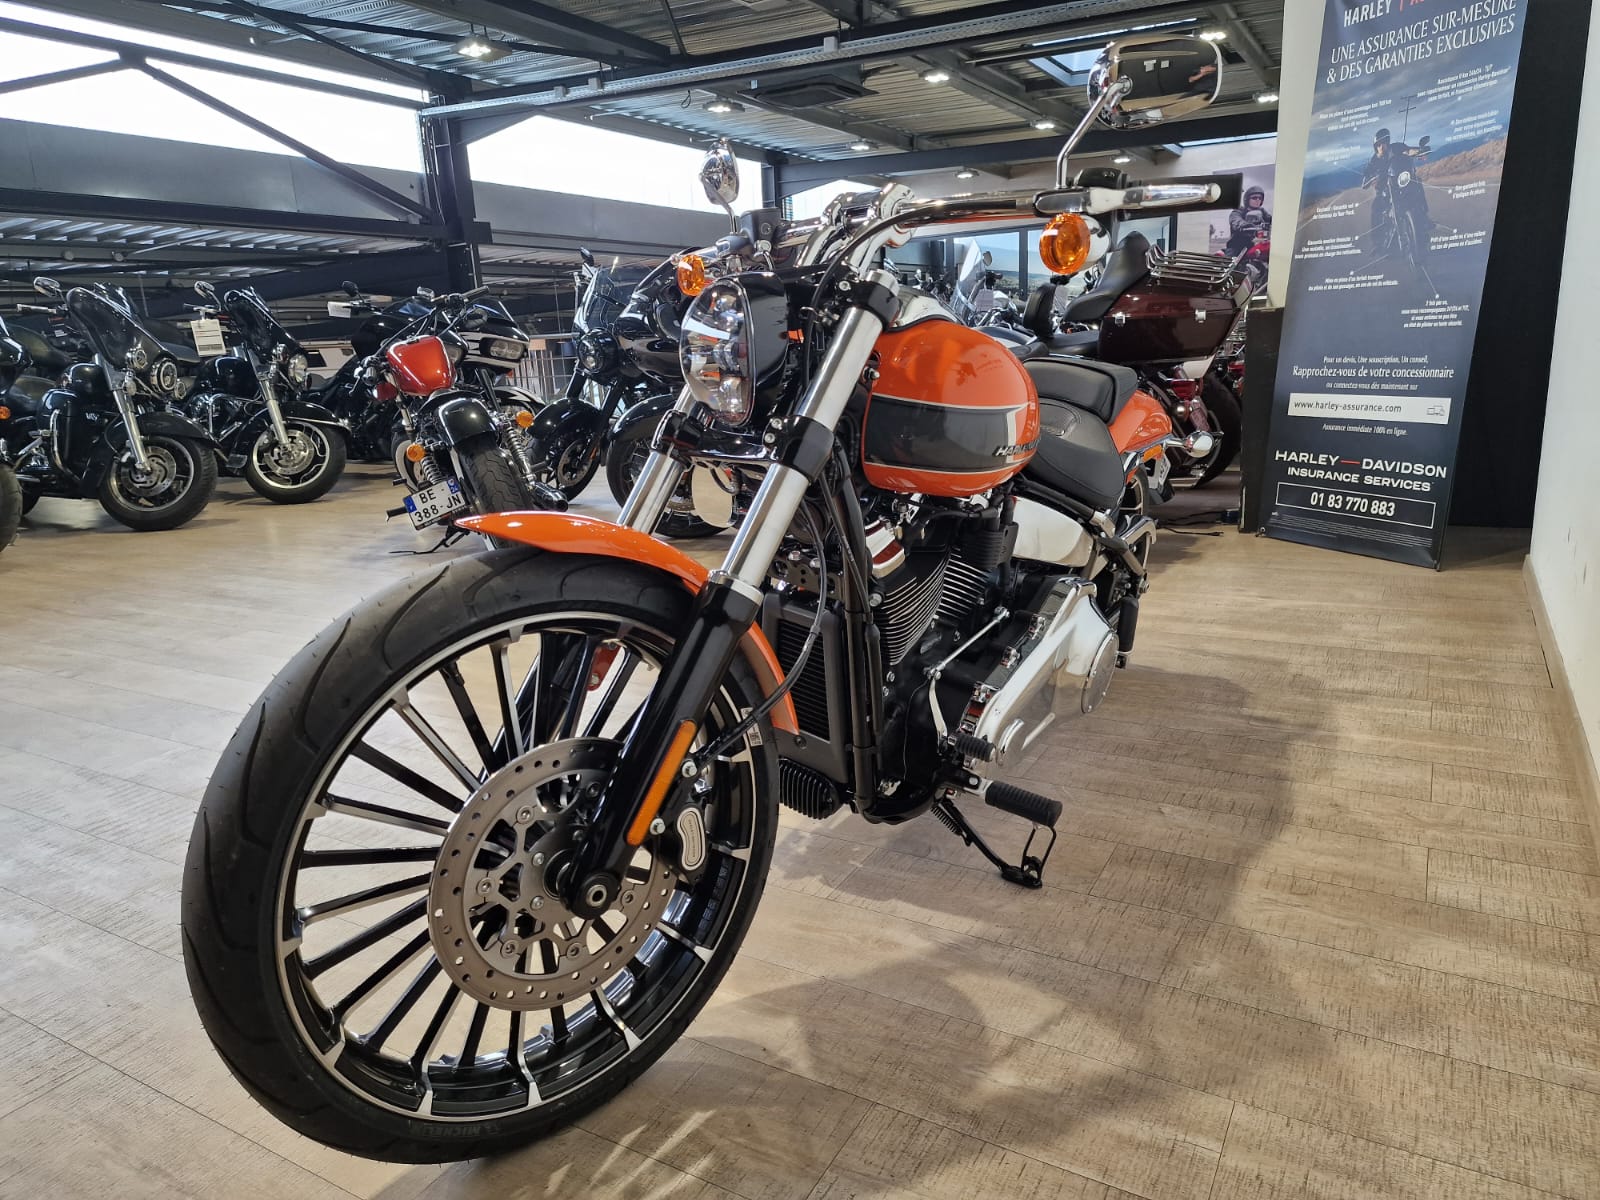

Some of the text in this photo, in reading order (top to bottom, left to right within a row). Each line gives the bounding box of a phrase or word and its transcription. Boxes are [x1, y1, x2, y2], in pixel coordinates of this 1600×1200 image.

[1344, 0, 1392, 27] HARLEY
[1326, 13, 1516, 84] & DES GARANTIES EXCLUSIVES
[1331, 42, 1355, 64] UNE
[1357, 19, 1429, 57] ASSURANCE
[1292, 366, 1455, 380] Rapprochez-vous de votre concessionnaire
[1294, 401, 1402, 413] www.harley-assurance.com
[1275, 450, 1447, 479] HARLEY DAVIDSON
[1287, 466, 1431, 492] INSURANCE SERVICES
[419, 488, 437, 504] BE
[1310, 491, 1395, 517] 01 83 770 883
